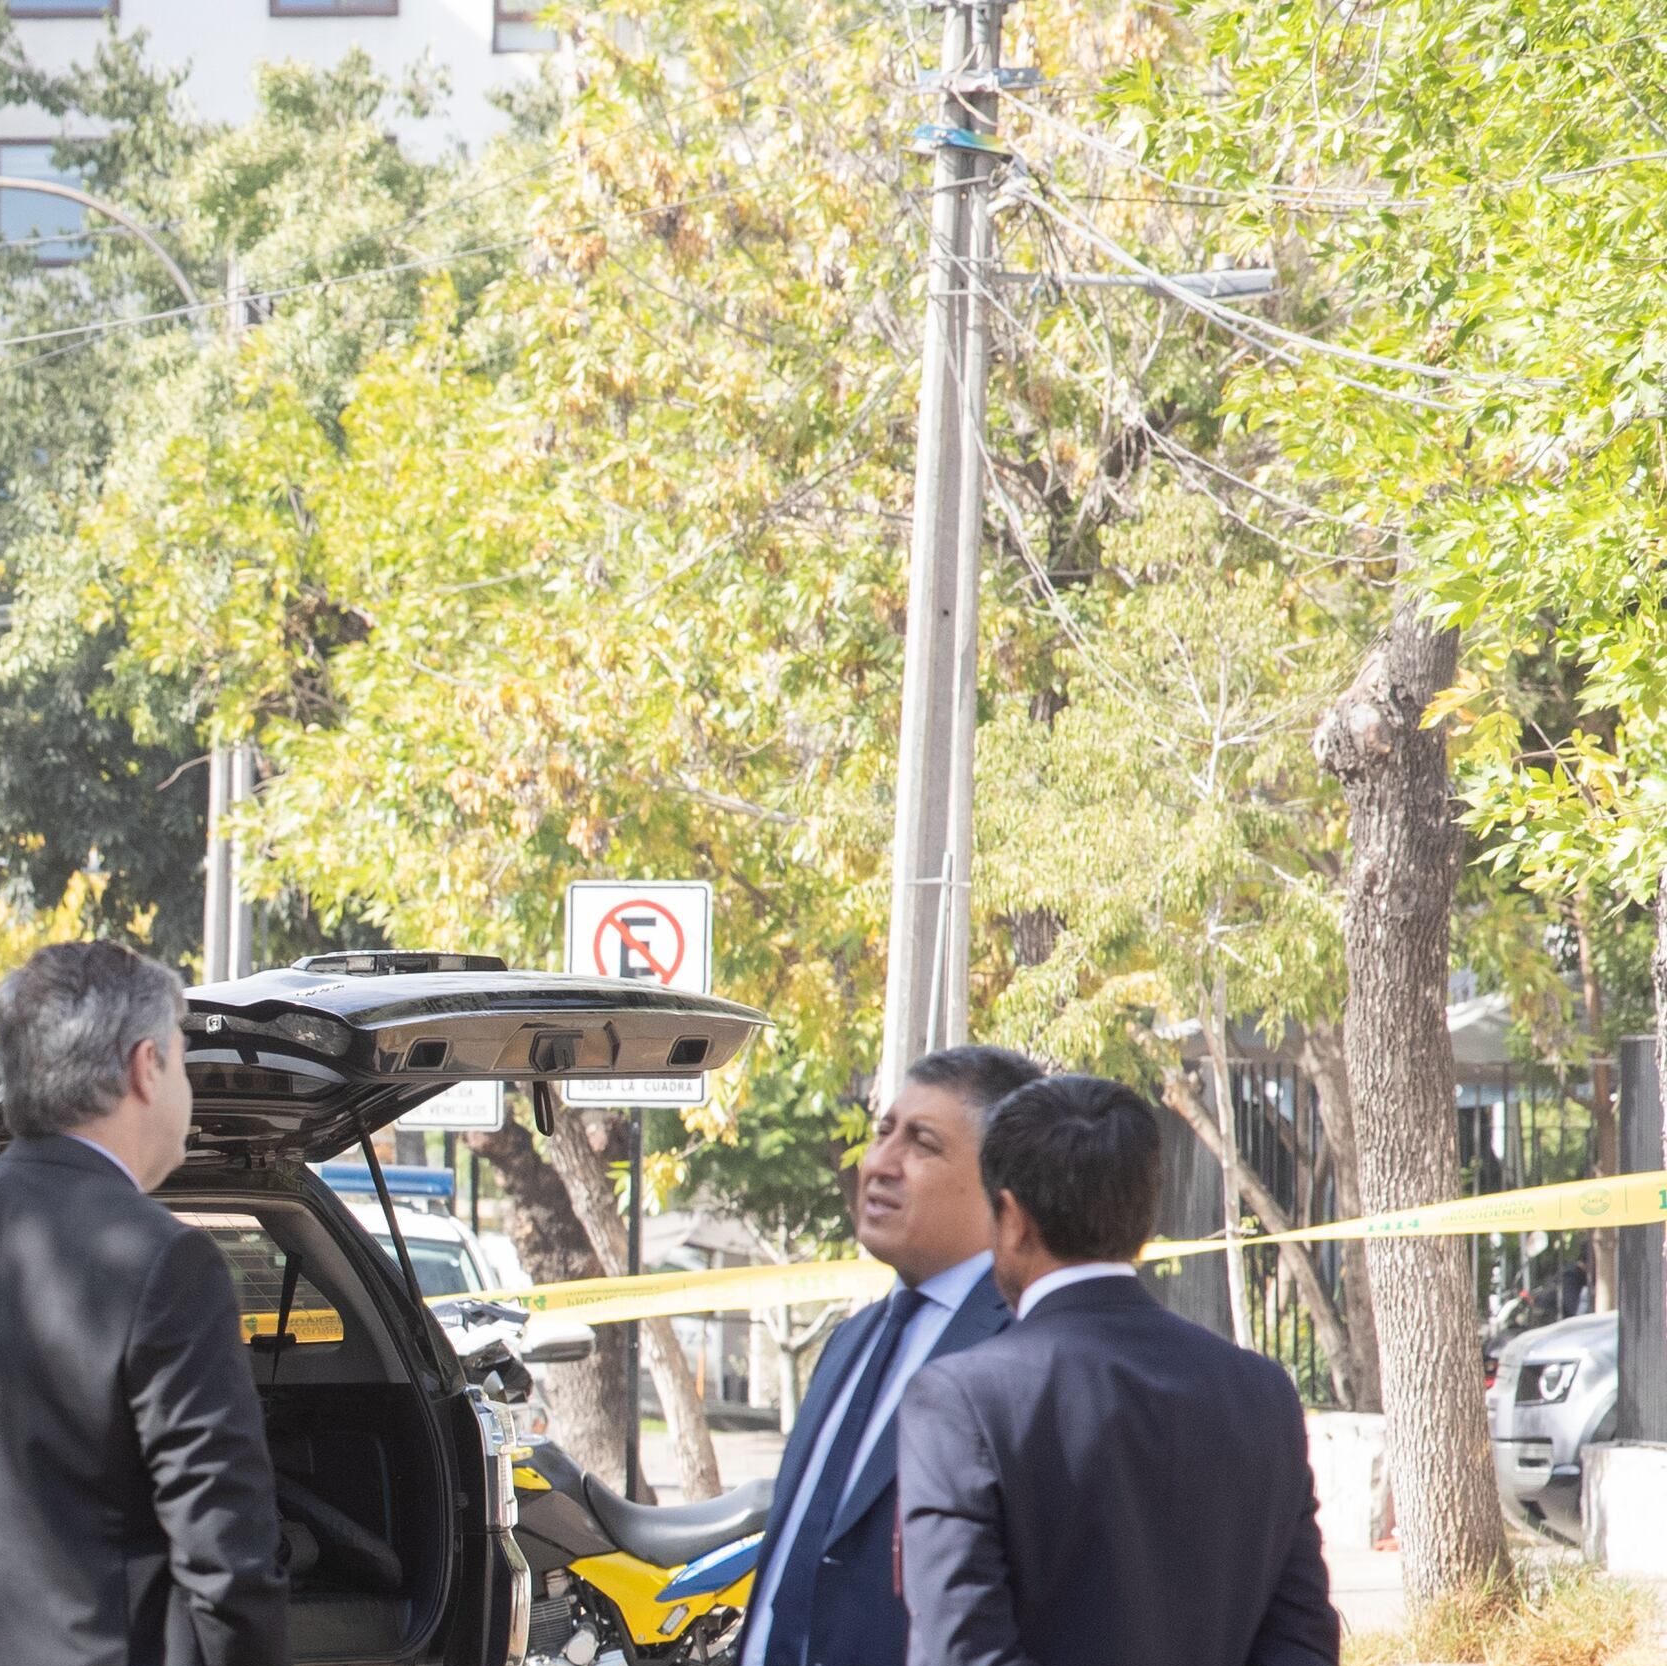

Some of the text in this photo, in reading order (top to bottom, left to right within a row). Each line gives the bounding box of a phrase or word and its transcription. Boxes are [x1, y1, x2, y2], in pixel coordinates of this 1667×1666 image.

[620, 917, 657, 978] E
[581, 1080, 693, 1092] TODA LA CUADRA
